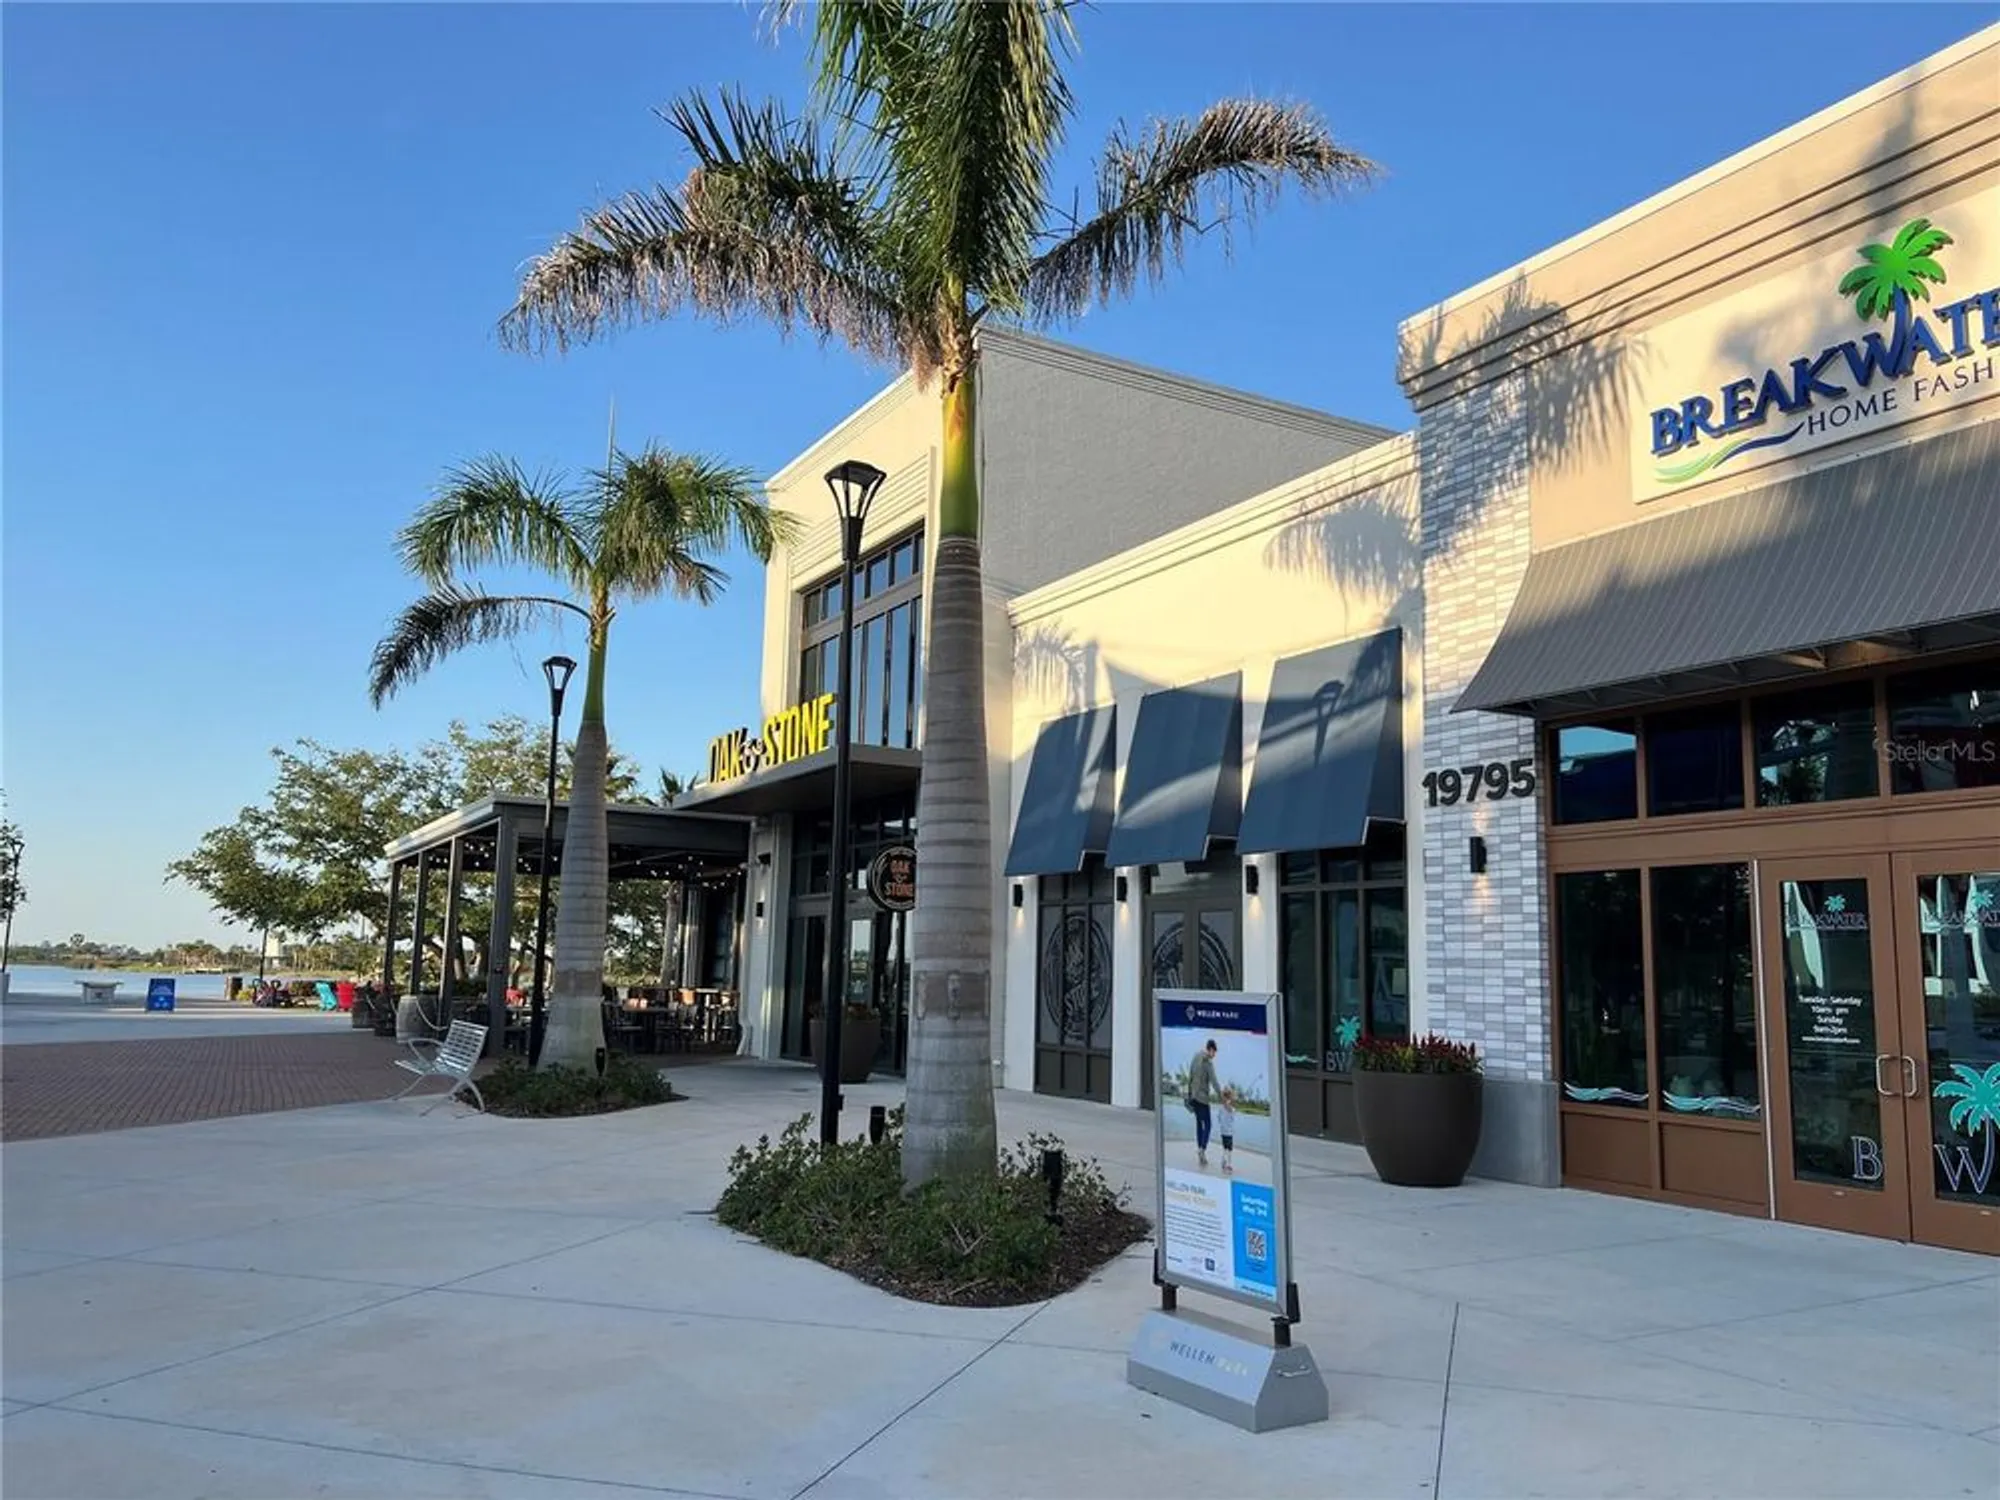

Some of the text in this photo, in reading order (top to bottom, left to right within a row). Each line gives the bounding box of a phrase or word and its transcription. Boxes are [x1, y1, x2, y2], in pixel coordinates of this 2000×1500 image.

[1807, 358, 1993, 436] HOME FASH
[708, 726, 748, 783] OAK
[763, 692, 836, 767] STONE
[1421, 758, 1536, 807] 19795
[884, 881, 914, 897] STONE
[891, 859, 910, 873] OAK
[1851, 1135, 1884, 1181] B
